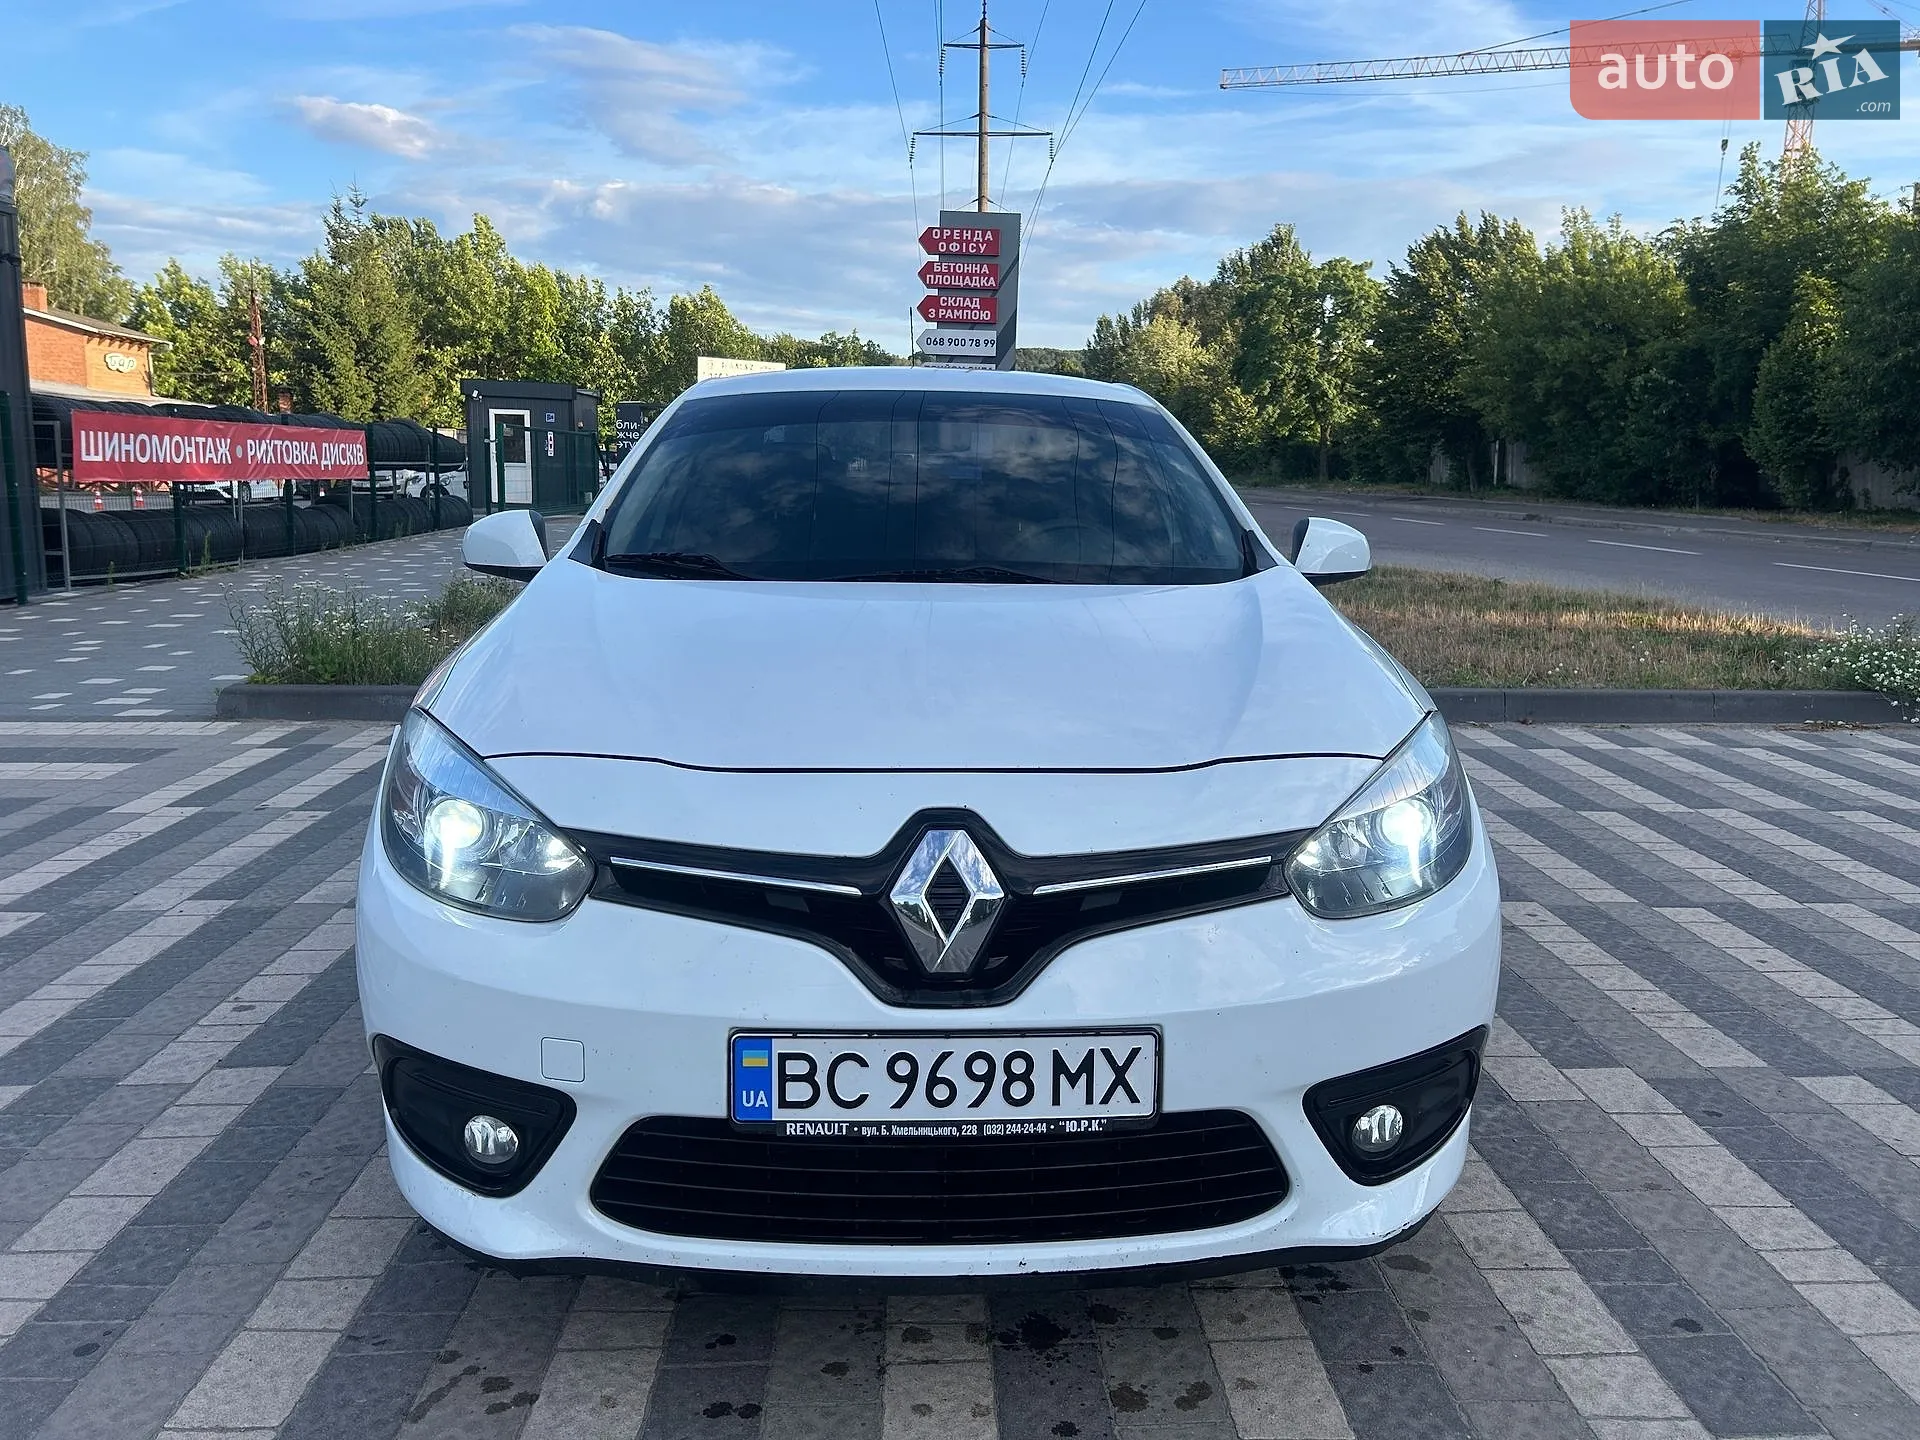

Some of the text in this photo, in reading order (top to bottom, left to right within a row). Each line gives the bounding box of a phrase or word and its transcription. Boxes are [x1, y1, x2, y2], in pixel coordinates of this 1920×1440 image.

[932, 228, 993, 242] ОРЕНДА
[938, 242, 987, 254] ОФІСУ
[933, 262, 989, 274] БЕТОННА
[926, 274, 996, 288] ПЛОЩАДКА
[939, 296, 981, 309] СКЛАД
[938, 308, 991, 321] РАМПОЮ
[926, 337, 996, 348] 068 900 78 99
[617, 431, 640, 440] жче
[80, 429, 365, 471] ШИНОМОНТАЖ РИХТОВКА ДИСКІВ
[777, 1046, 1142, 1110] BC 9698 MX
[742, 1090, 769, 1108] UA
[785, 1122, 850, 1136] RENAULT
[861, 1125, 880, 1137] вул.
[881, 1124, 890, 1136] Б.
[891, 1124, 960, 1137] Хмельницького,
[961, 1124, 978, 1136] 228
[983, 1123, 1005, 1136] (032)
[1005, 1122, 1047, 1135] 244-24-44
